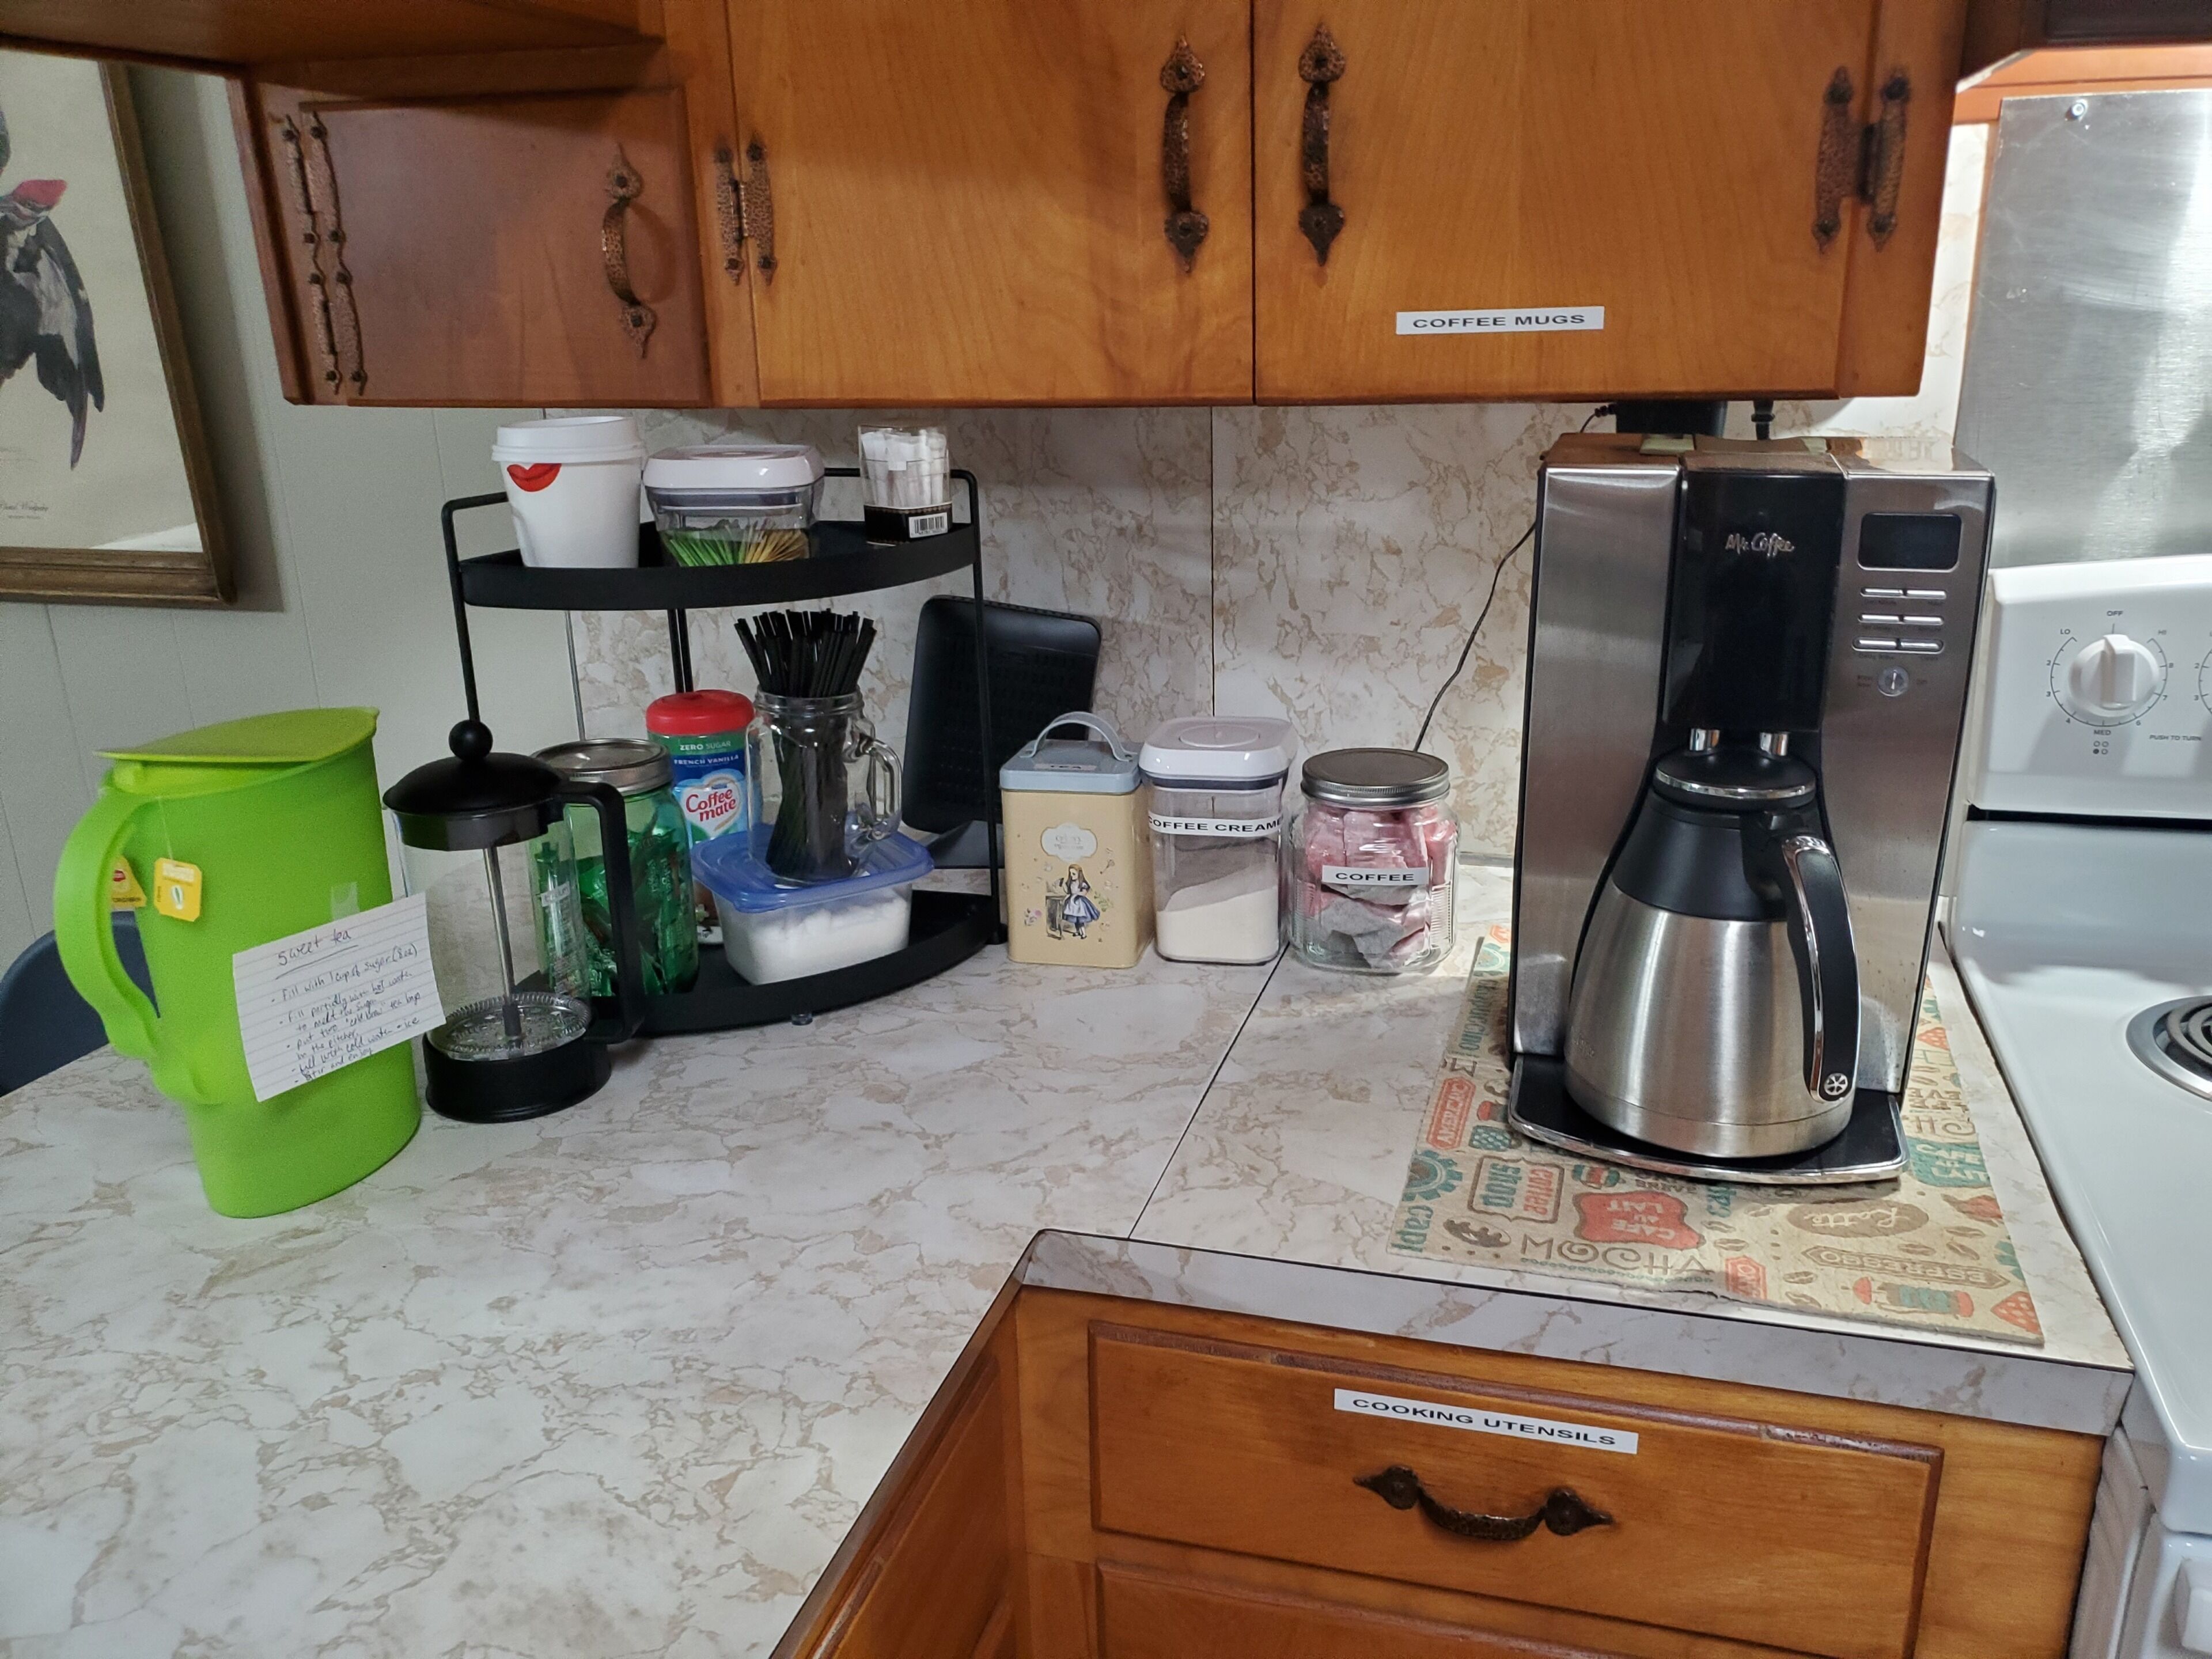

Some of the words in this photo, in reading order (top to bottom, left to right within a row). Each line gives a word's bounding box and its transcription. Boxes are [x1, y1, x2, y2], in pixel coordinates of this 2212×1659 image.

[1412, 316, 1506, 329] COFFEE
[1514, 314, 1586, 326] MUGS
[1751, 532, 1796, 557] Coffee
[679, 743, 704, 751] ZERO
[705, 740, 732, 750] SUGAR
[707, 754, 739, 764] VANILLA
[685, 788, 733, 813] Coffee
[699, 798, 737, 822] mate
[1335, 872, 1415, 882] COFFEE
[331, 927, 352, 946] tea
[304, 975, 325, 993] with
[1479, 1162, 1522, 1209] shop
[1606, 1199, 1665, 1215] LAIT
[1611, 1218, 1676, 1241] CAFE
[1521, 1233, 1715, 1277] MOCHA
[1819, 1249, 1987, 1284] ESPRESSO
[1352, 1398, 1474, 1425] COOKING
[1483, 1418, 1616, 1446] UTENSILS
